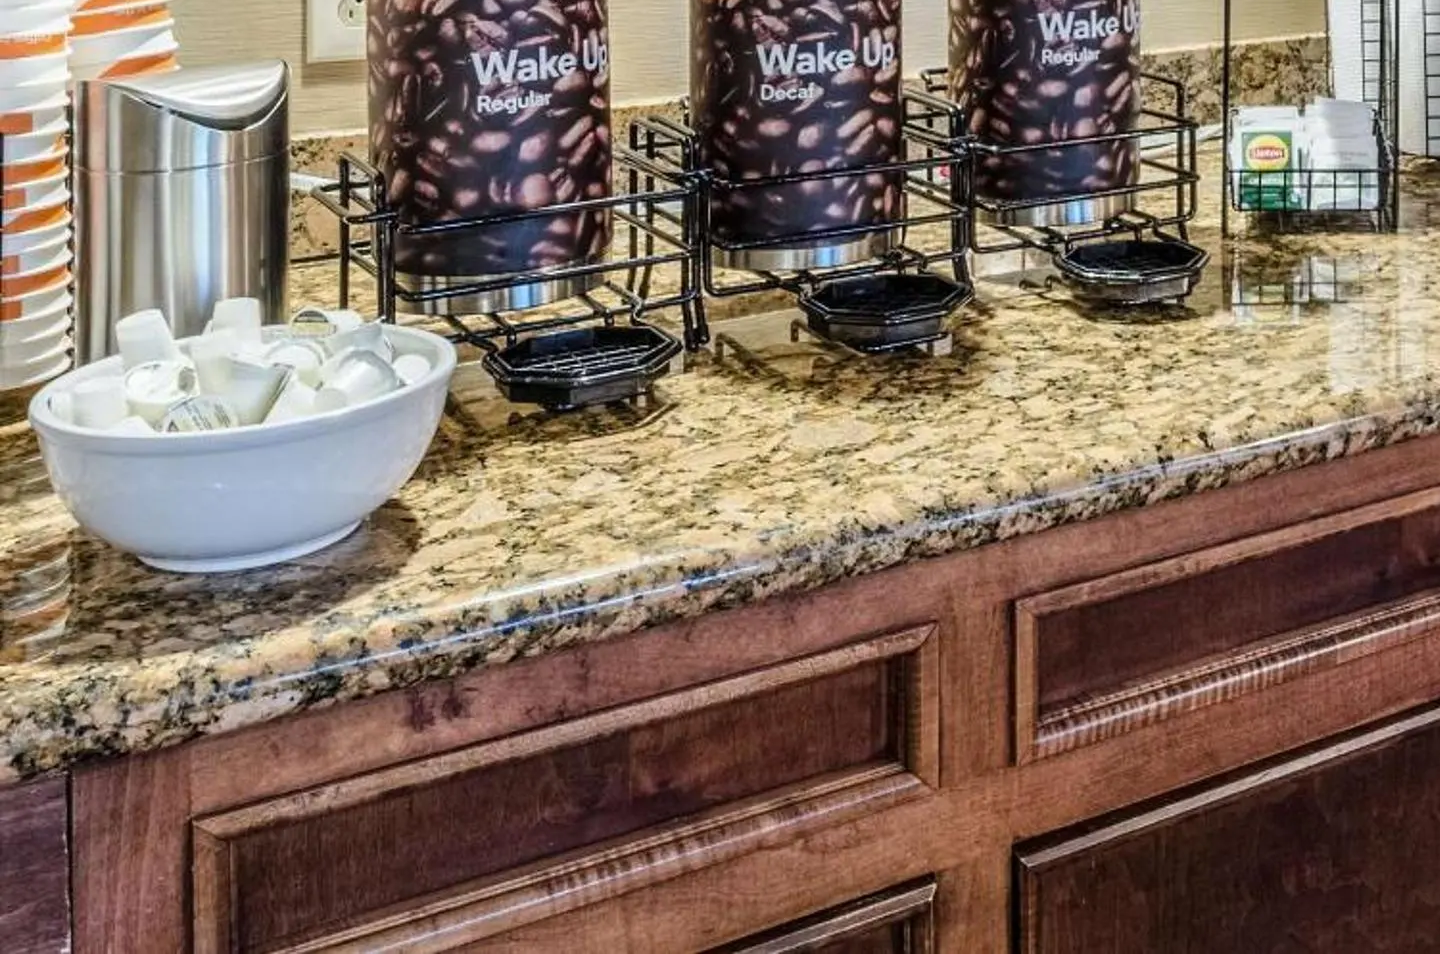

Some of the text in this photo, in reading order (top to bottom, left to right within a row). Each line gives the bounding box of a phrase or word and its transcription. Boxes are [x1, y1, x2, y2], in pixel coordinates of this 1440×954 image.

[1038, 9, 1119, 42] Wake
[471, 37, 608, 86] Wake Up
[756, 36, 895, 76] Wake Up
[1041, 47, 1101, 66] Regular
[477, 90, 553, 114] Regular
[760, 82, 815, 102] Decaf
